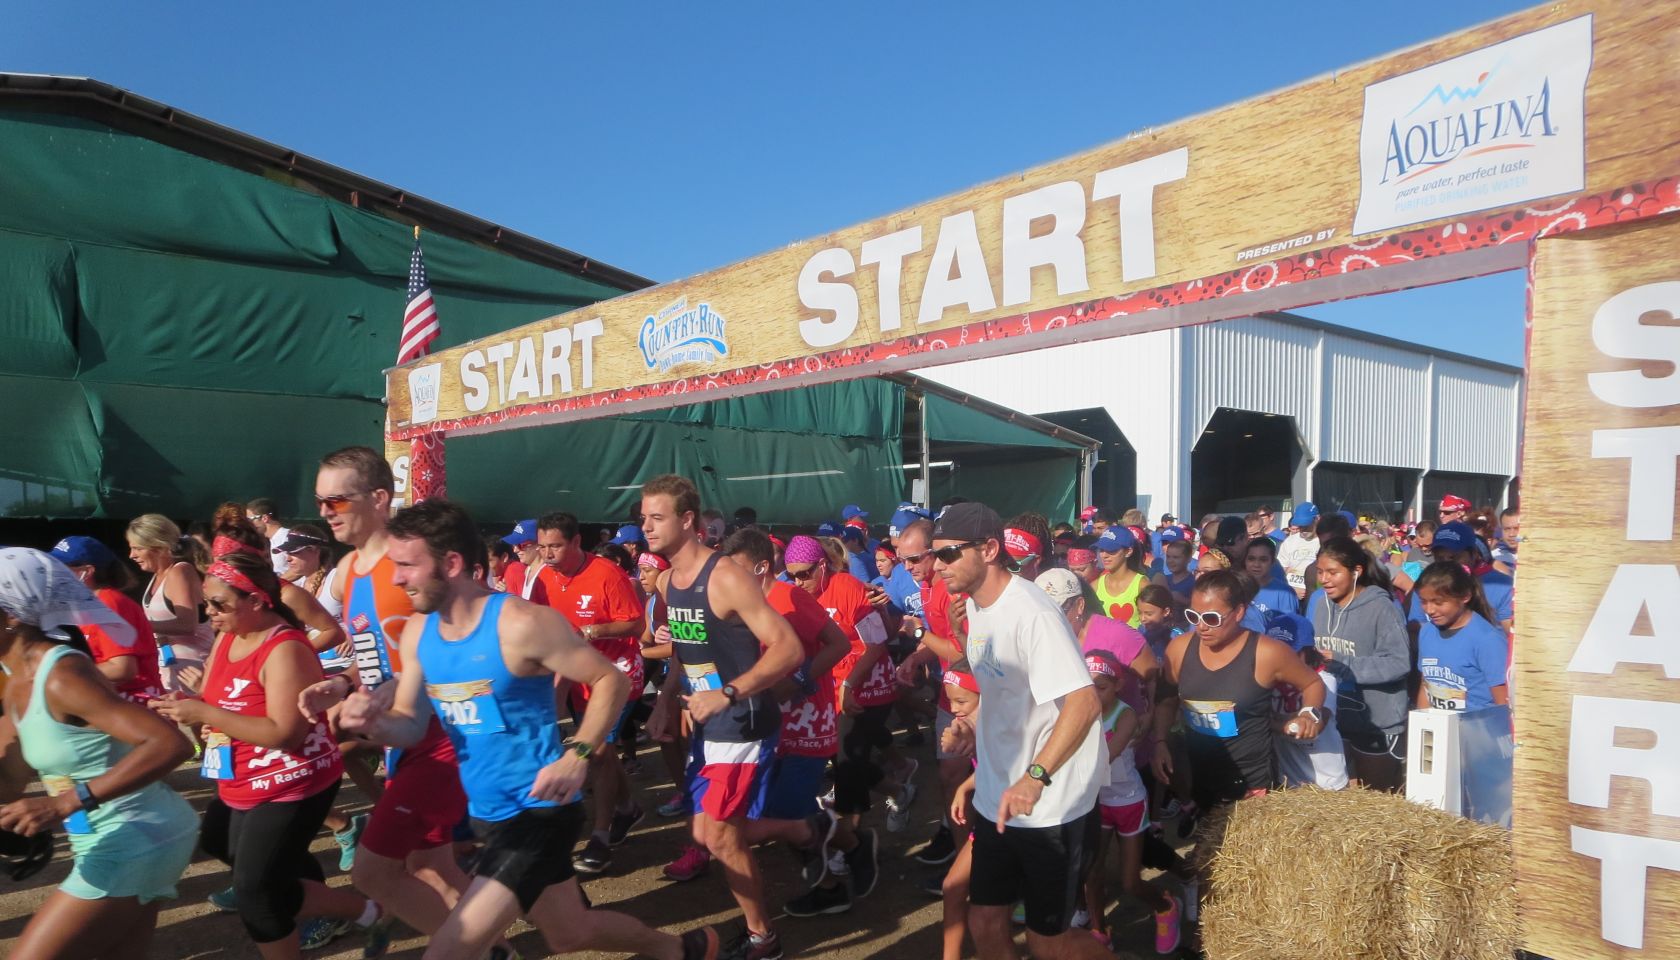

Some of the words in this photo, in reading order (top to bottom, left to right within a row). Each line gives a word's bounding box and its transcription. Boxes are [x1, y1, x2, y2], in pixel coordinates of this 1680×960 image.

[1379, 76, 1557, 185] AQUAFINA
[1395, 185, 1420, 200] pure
[1457, 166, 1498, 186] perfect
[1500, 159, 1530, 175] taste
[797, 147, 1188, 348] START
[1237, 234, 1313, 261] PRESENTED
[1316, 228, 1336, 241] BY
[461, 317, 604, 412] START
[440, 700, 482, 725] 202
[1190, 711, 1220, 730] 315
[252, 780, 270, 790] My
